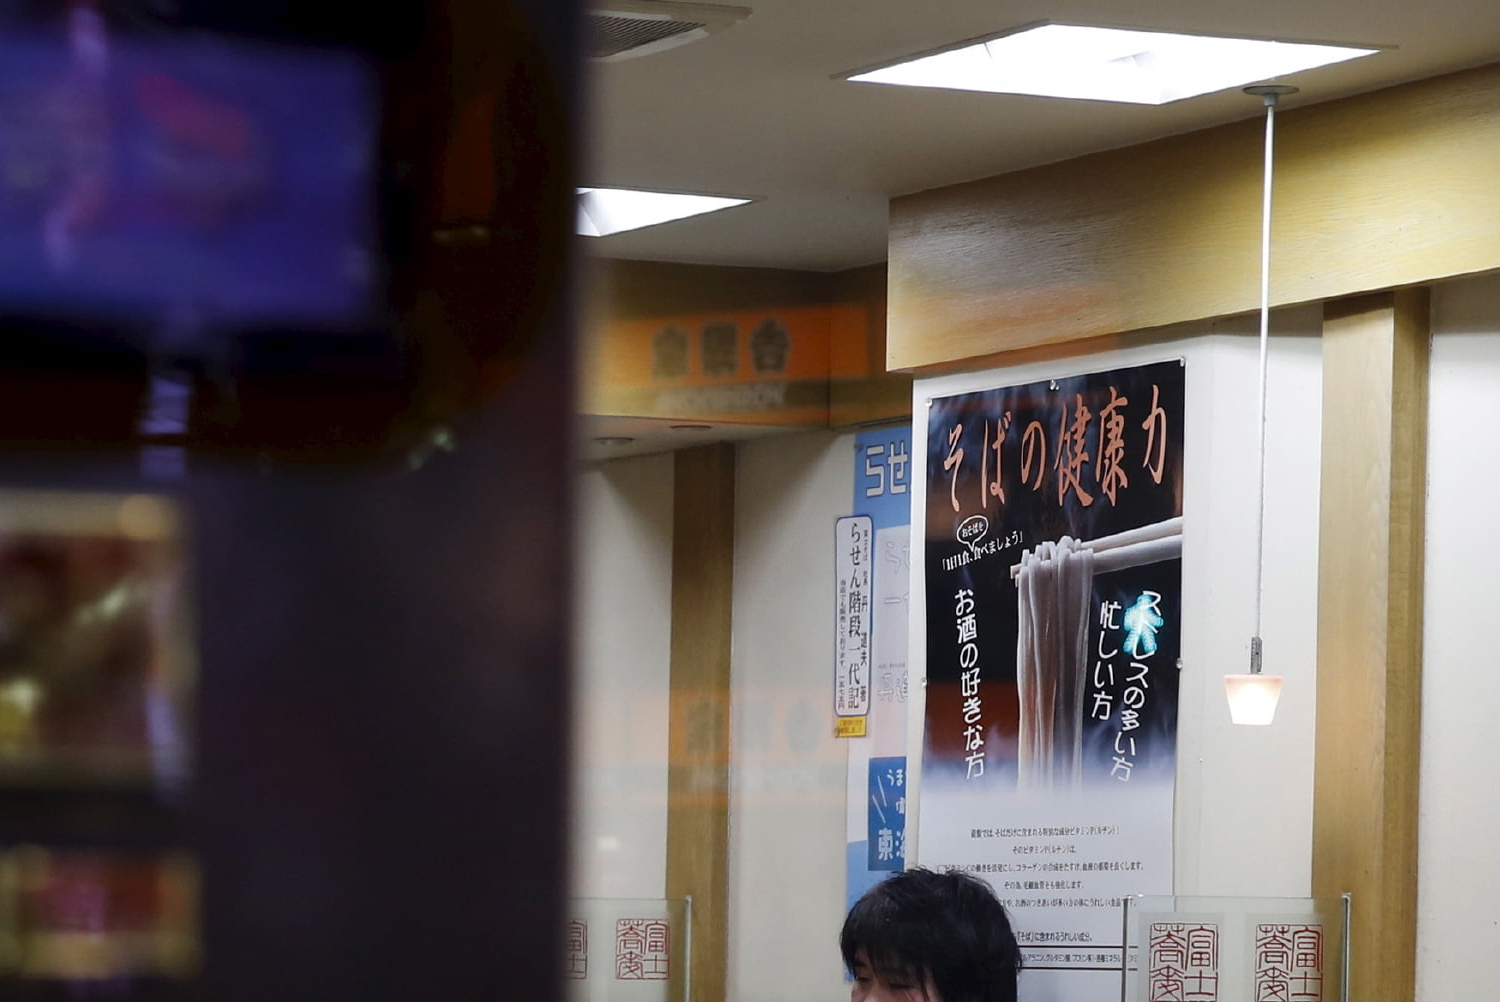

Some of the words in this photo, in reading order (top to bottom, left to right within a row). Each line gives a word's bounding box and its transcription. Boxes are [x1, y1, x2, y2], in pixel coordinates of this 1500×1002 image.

[943, 384, 1168, 513] そばの健康力
[849, 522, 861, 709] らせん階段一代記
[954, 588, 985, 780] お酒の好きな方
[1091, 600, 1122, 721] 忙しい方
